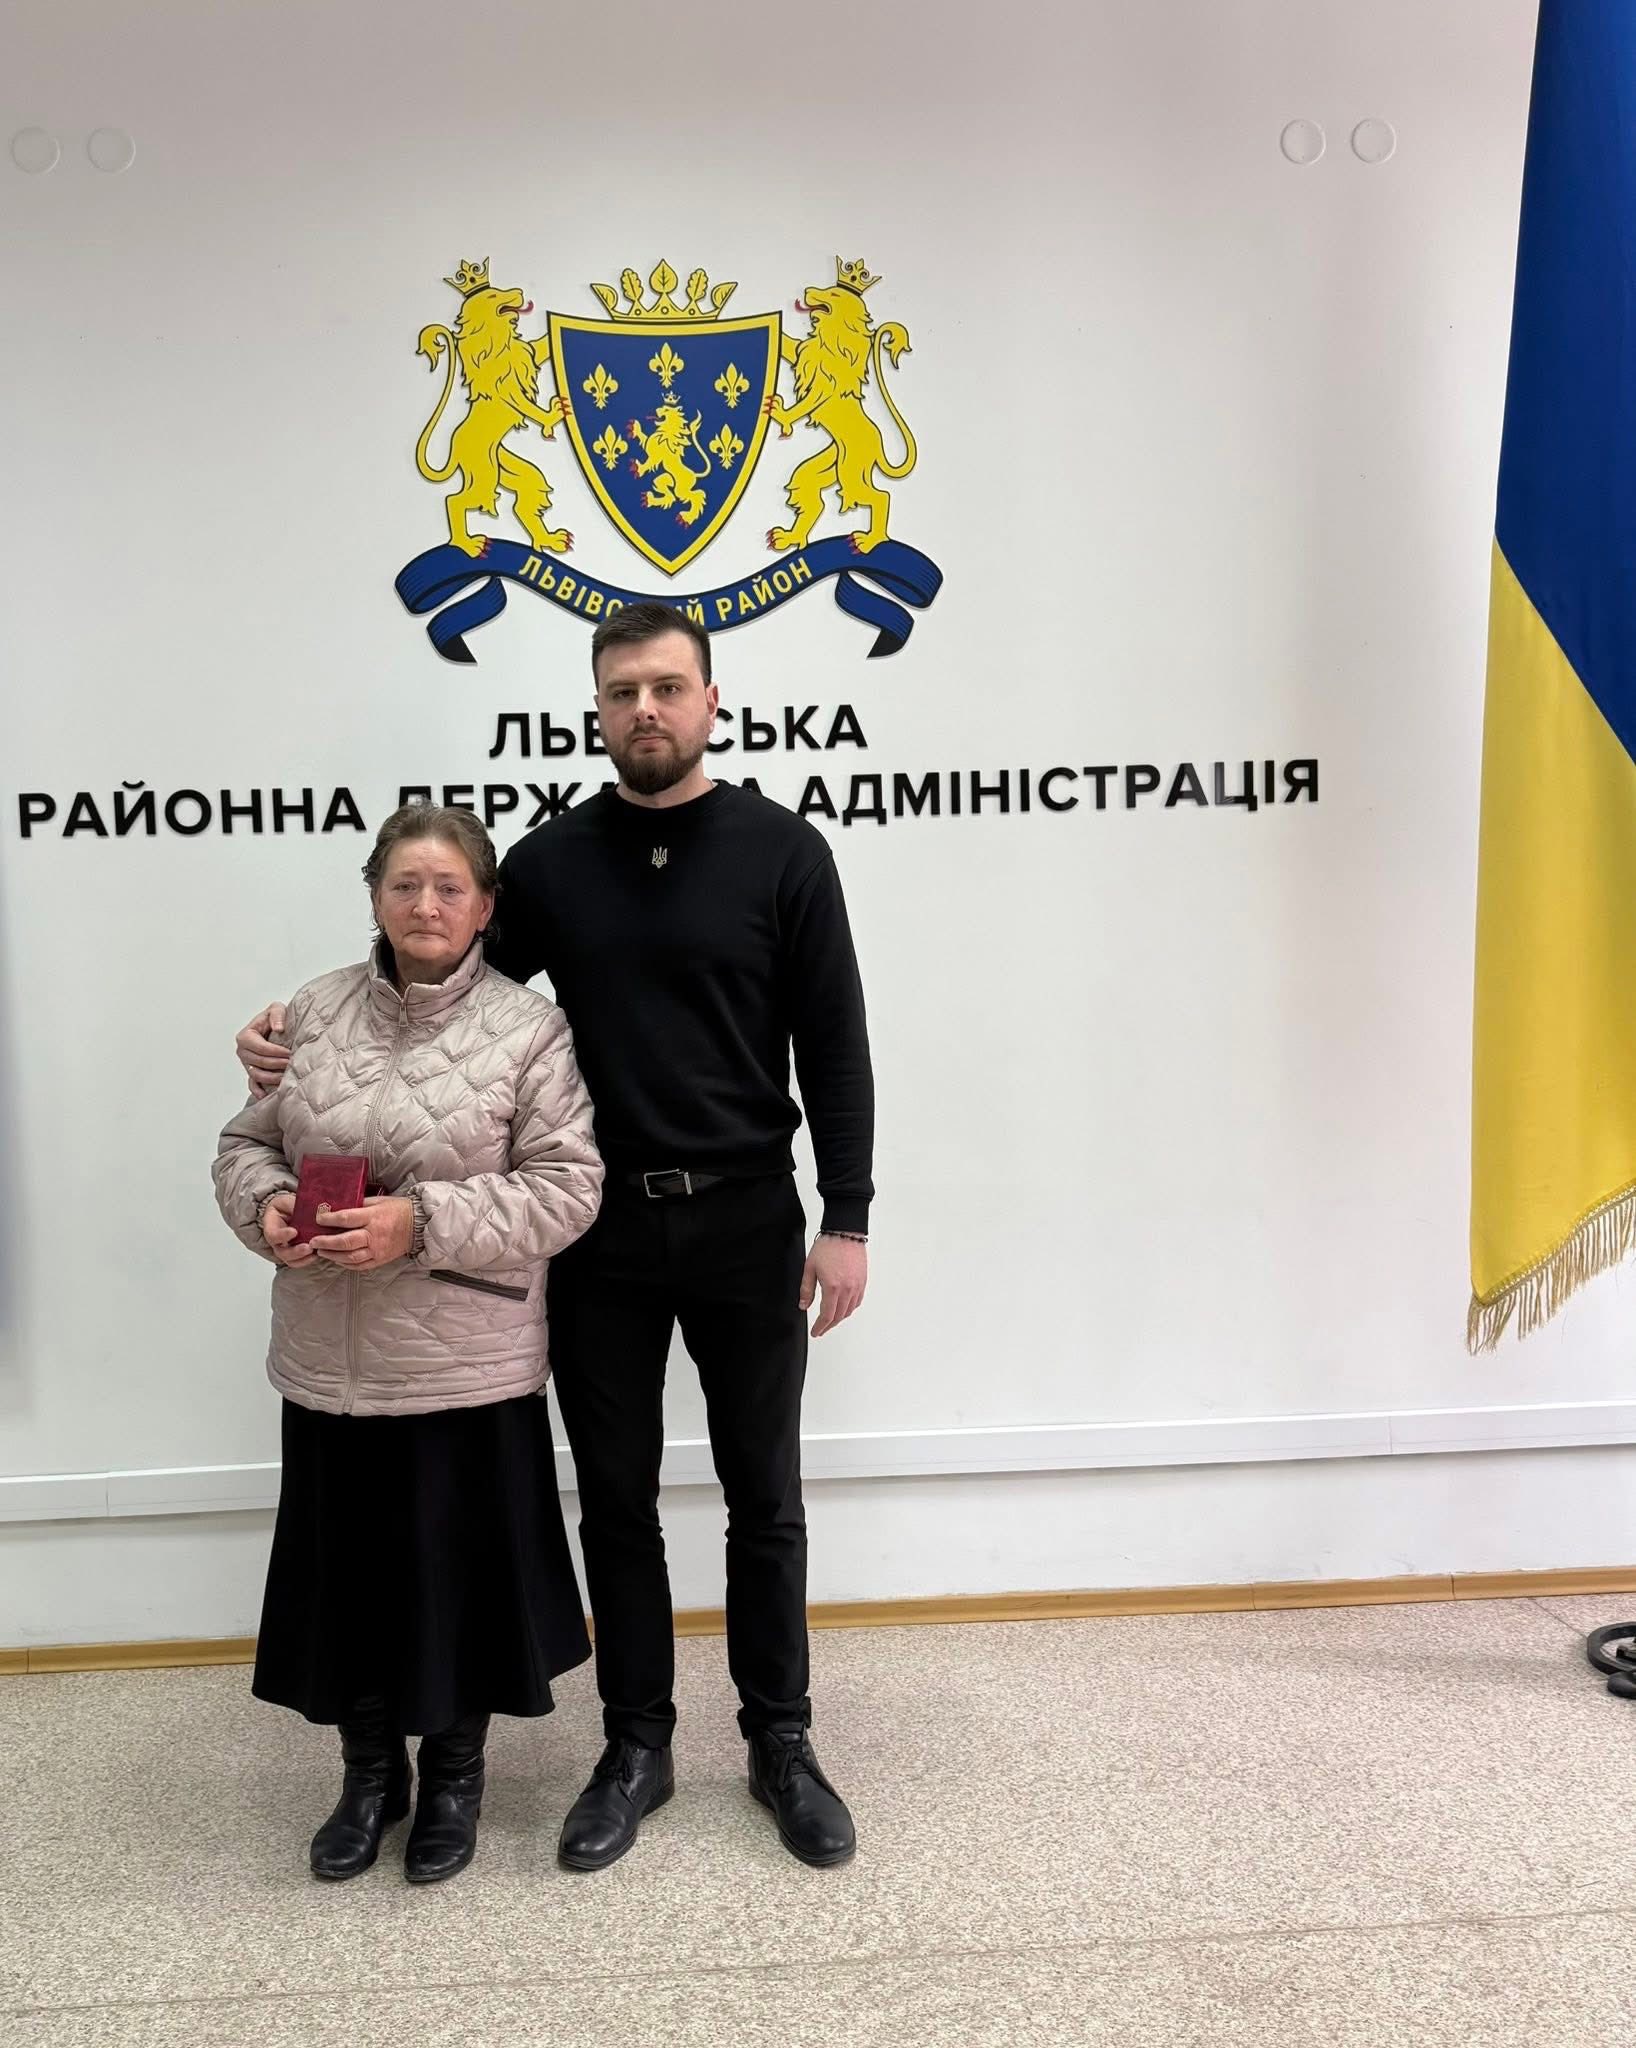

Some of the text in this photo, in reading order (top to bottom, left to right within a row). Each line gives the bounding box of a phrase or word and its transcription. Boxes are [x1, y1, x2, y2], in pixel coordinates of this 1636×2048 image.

[518, 555, 813, 626] ЛЬВІВСЙ РАЙОН
[489, 705, 868, 757] ЛЬВСЬКА
[18, 780, 367, 838] РАЙОННА
[797, 759, 1319, 826] АДМІНІСТРАЦІЯ
